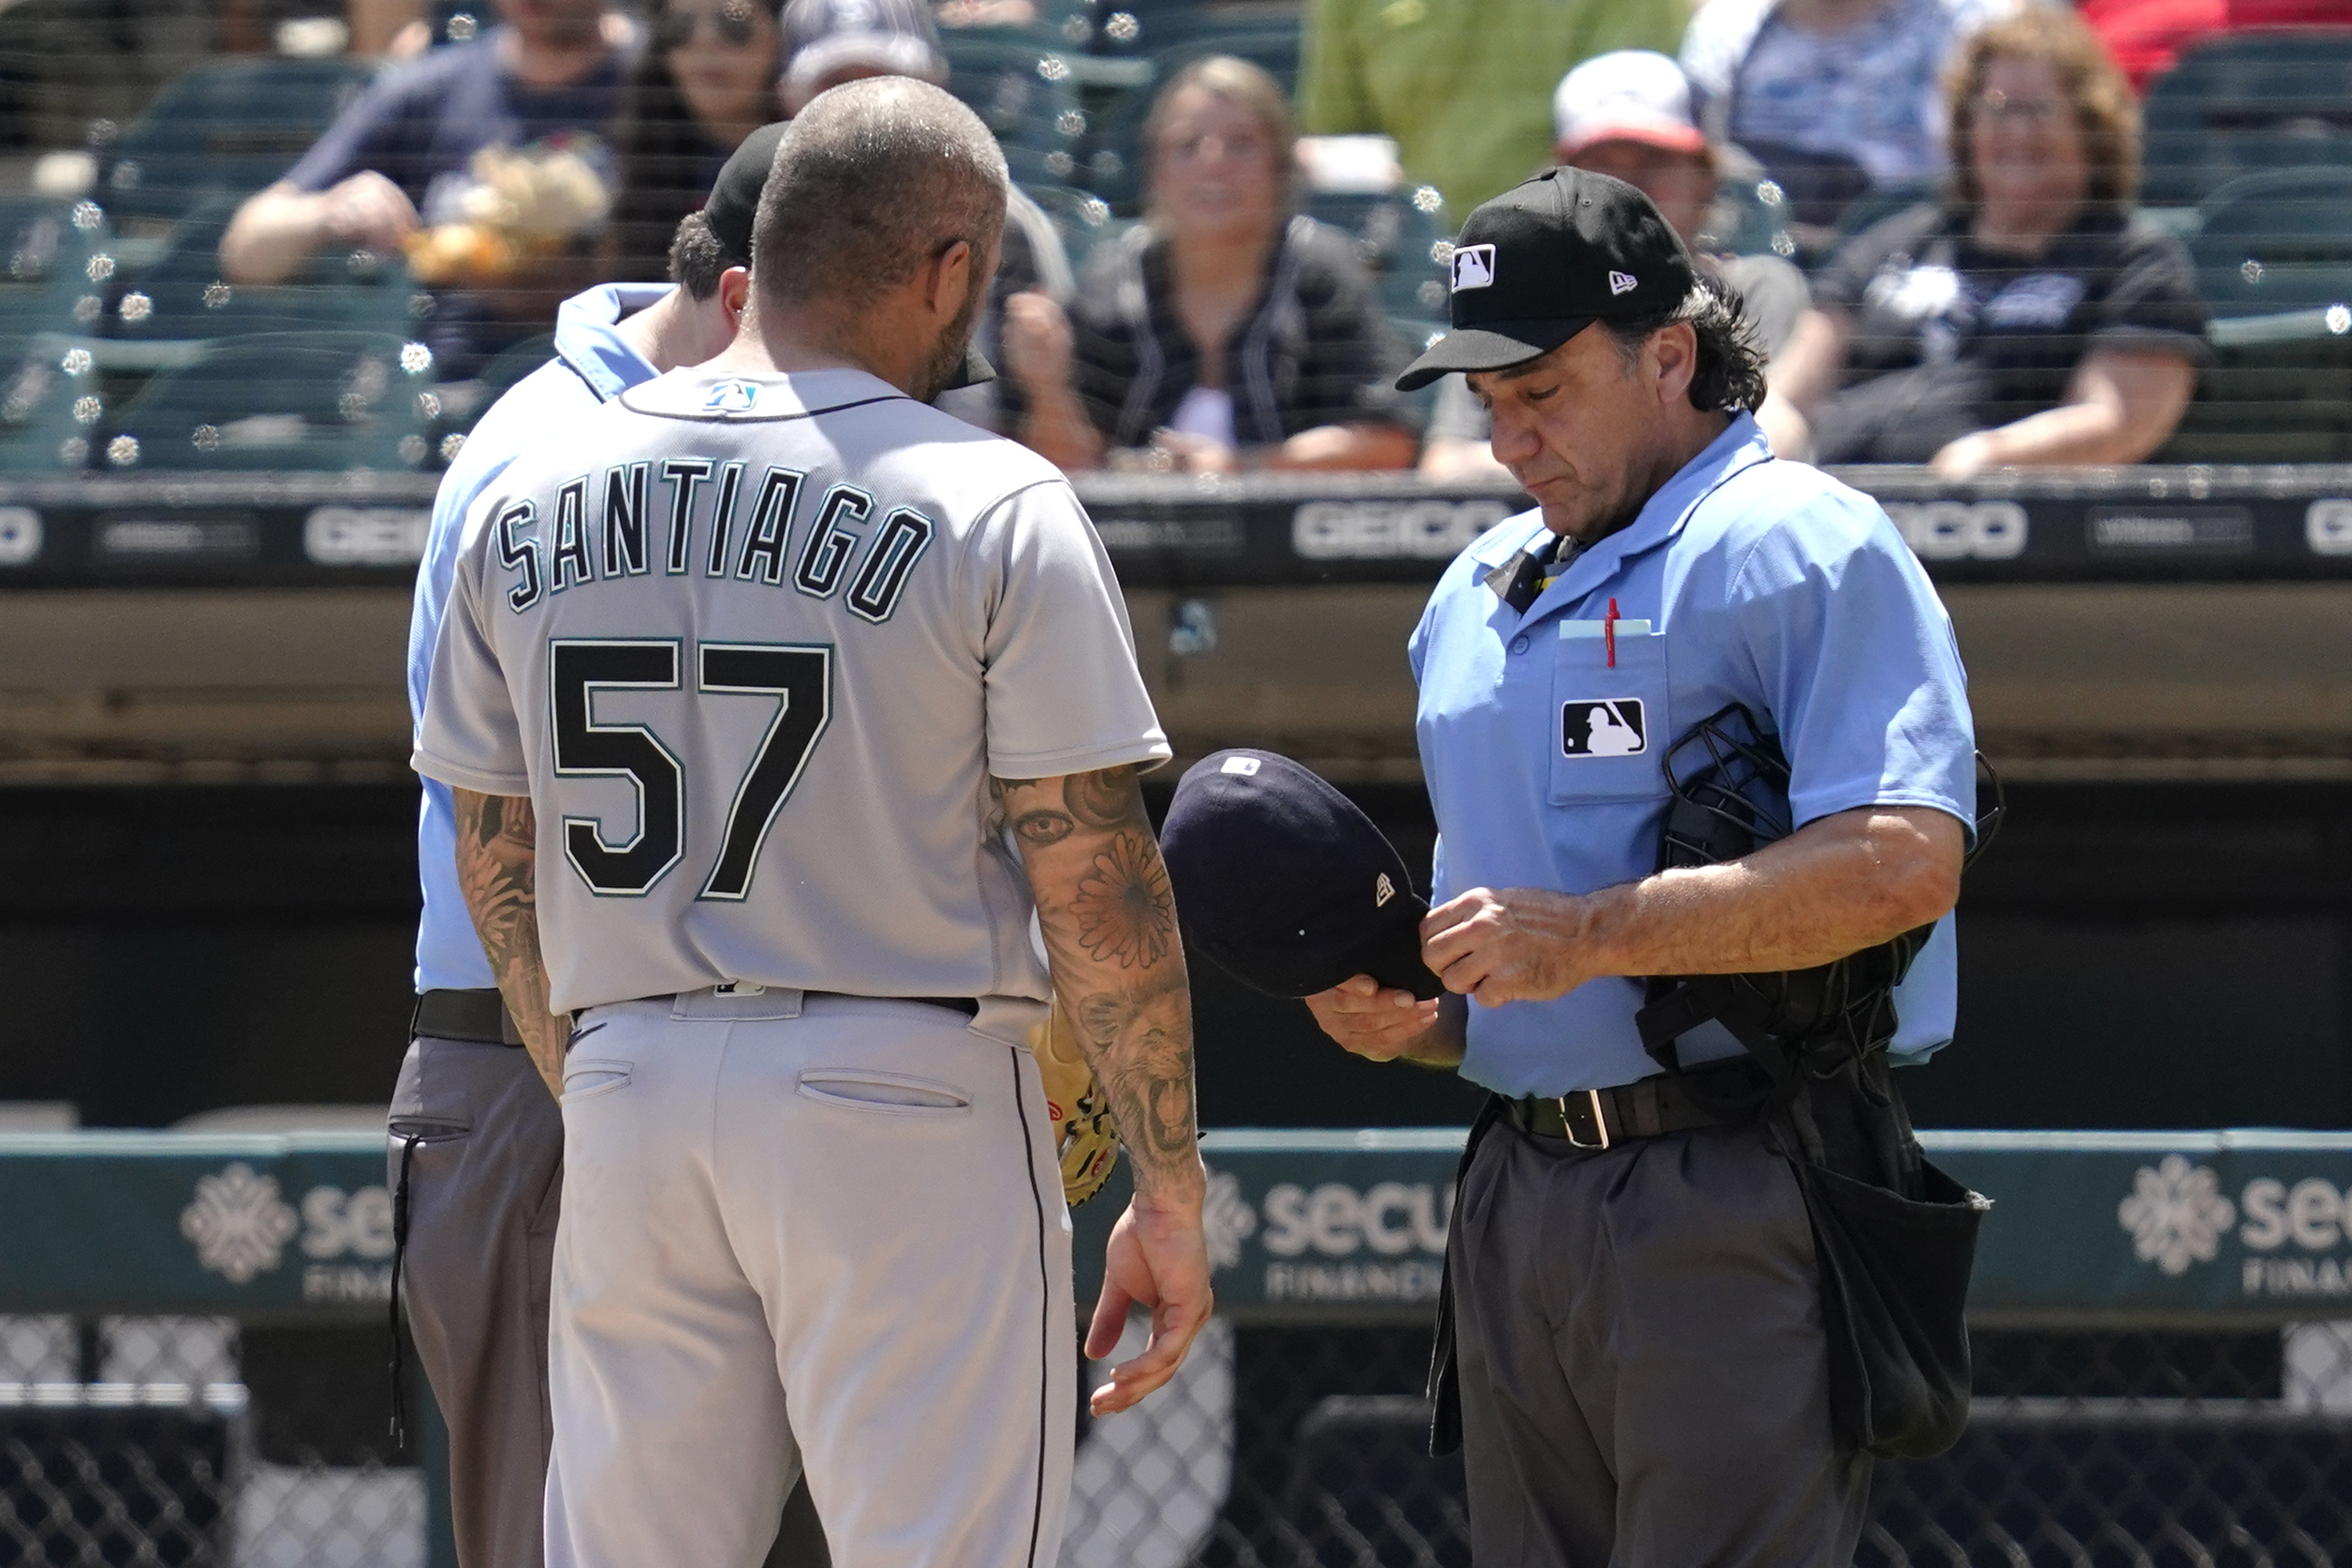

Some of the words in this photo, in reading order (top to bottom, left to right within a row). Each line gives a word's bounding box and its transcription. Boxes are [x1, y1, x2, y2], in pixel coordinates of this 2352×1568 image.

[304, 506, 432, 565] GEI
[496, 458, 936, 625] SANTIAGO
[1293, 499, 1513, 561] GEICO
[549, 636, 834, 903] 57
